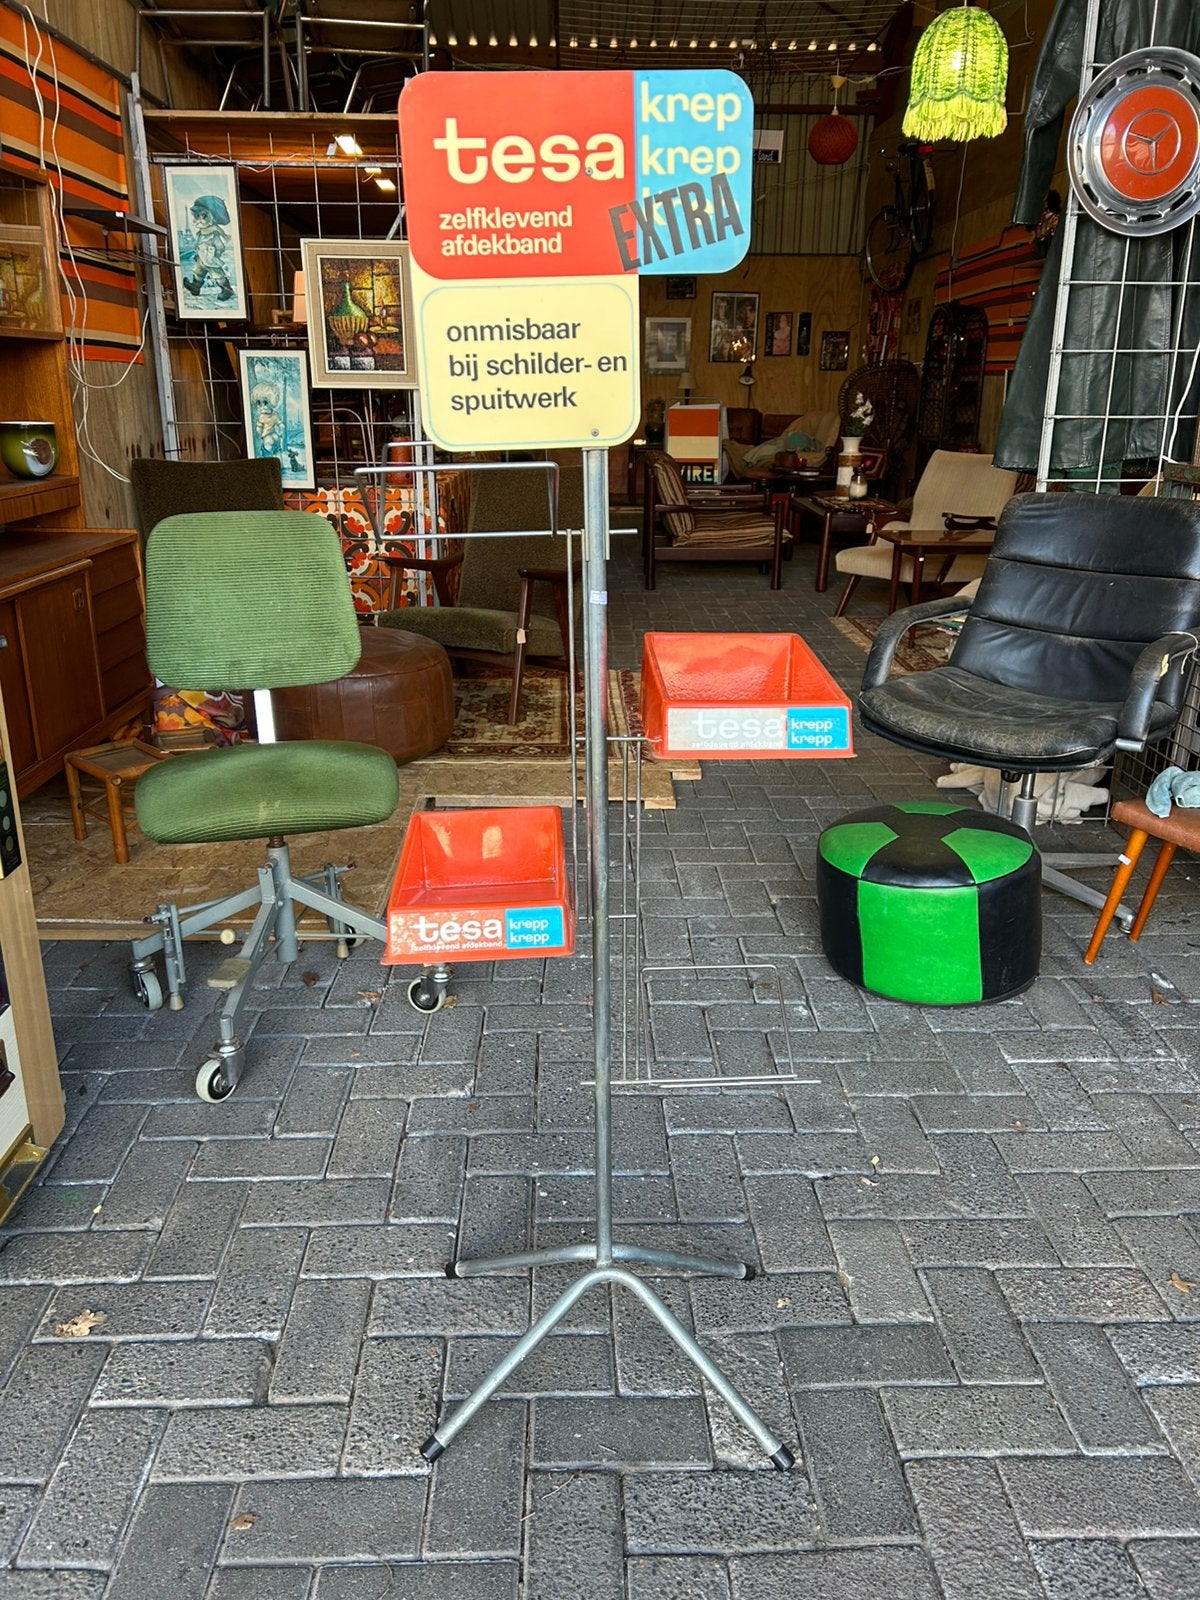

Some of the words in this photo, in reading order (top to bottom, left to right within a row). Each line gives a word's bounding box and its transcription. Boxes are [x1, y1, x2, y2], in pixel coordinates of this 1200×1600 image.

[640, 81, 742, 132] krep
[433, 118, 625, 184] tesa
[439, 205, 573, 230] zelfklevend
[608, 173, 744, 272] EXTRA
[441, 232, 563, 256] afdekband
[446, 318, 581, 342] onmisbaar
[449, 354, 478, 382] bij
[486, 352, 593, 375] schilder-
[597, 354, 628, 372] en
[450, 386, 578, 415] spuitwerk
[691, 711, 784, 739] tesa
[791, 718, 833, 733] krepp
[791, 732, 833, 747] krepp
[410, 916, 503, 943] tesa
[509, 919, 549, 931] krepp
[509, 931, 550, 945] krepp
